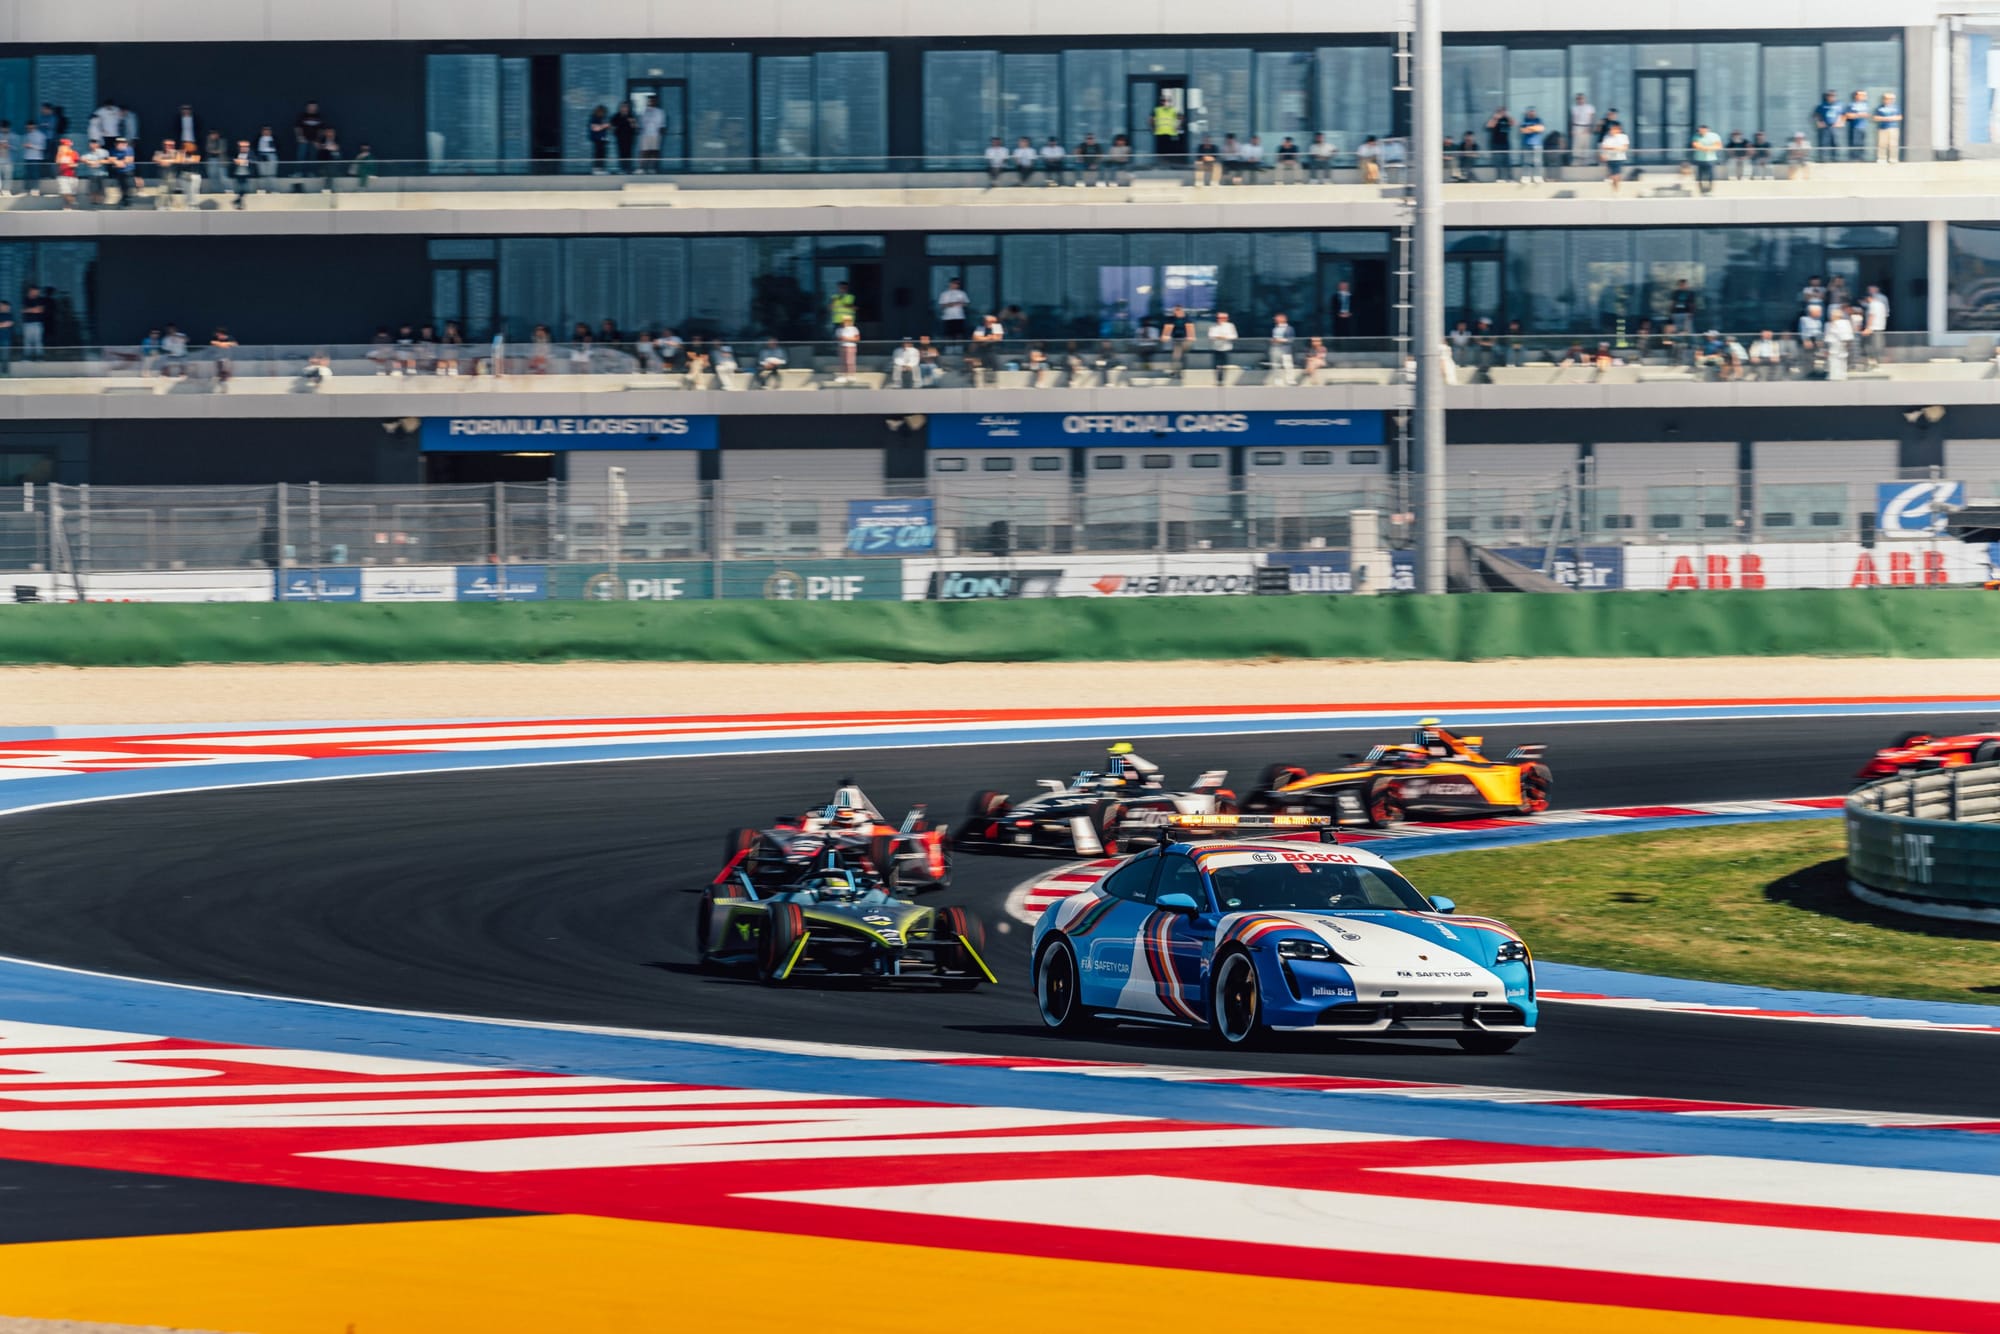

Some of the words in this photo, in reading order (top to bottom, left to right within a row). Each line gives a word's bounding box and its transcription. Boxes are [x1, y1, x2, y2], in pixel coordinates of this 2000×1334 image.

[450, 418, 557, 435] FORMULA
[558, 418, 576, 435] E
[577, 418, 689, 435] LOGISTICS
[1062, 415, 1176, 433] OFFICIAL
[1176, 414, 1249, 433] CARS
[1667, 554, 1766, 589] ABB
[1851, 550, 1948, 587] ABB
[627, 578, 685, 600] PIF
[806, 575, 866, 600] PIF
[1281, 852, 1358, 864] BOSCH
[1094, 960, 1118, 972] SAFETY
[1118, 963, 1130, 974] CAR
[1312, 986, 1336, 997] Julius
[1337, 987, 1354, 996] Bär
